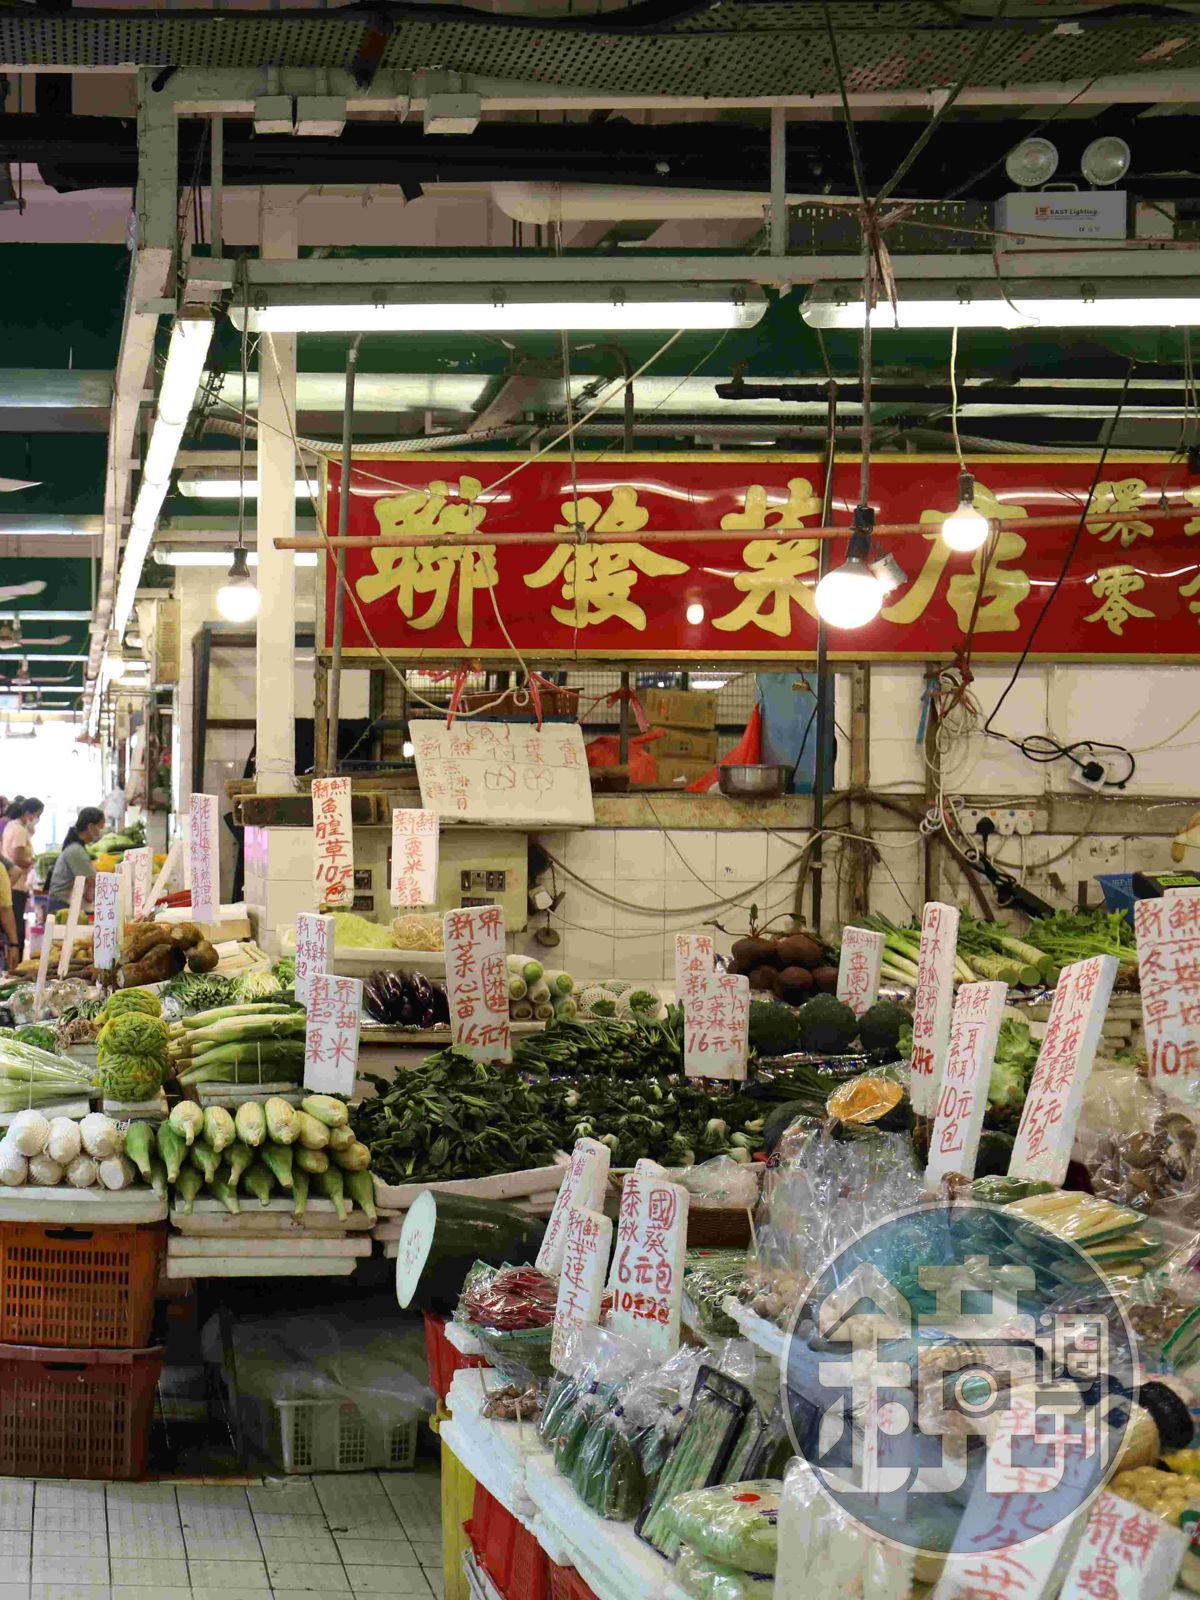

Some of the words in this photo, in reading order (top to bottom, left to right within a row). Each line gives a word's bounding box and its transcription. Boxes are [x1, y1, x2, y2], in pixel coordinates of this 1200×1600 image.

[1085, 477, 1200, 548] 環
[355, 475, 1031, 647] 聯發菜店
[1083, 564, 1200, 637] 零
[393, 809, 437, 834] 新鮮
[447, 908, 504, 941] 新界
[308, 975, 357, 1003] 新界
[685, 975, 739, 1000] 新界
[955, 985, 990, 1018] 新鮮
[620, 1176, 677, 1231] 泰國
[567, 1206, 600, 1252] 新鮮
